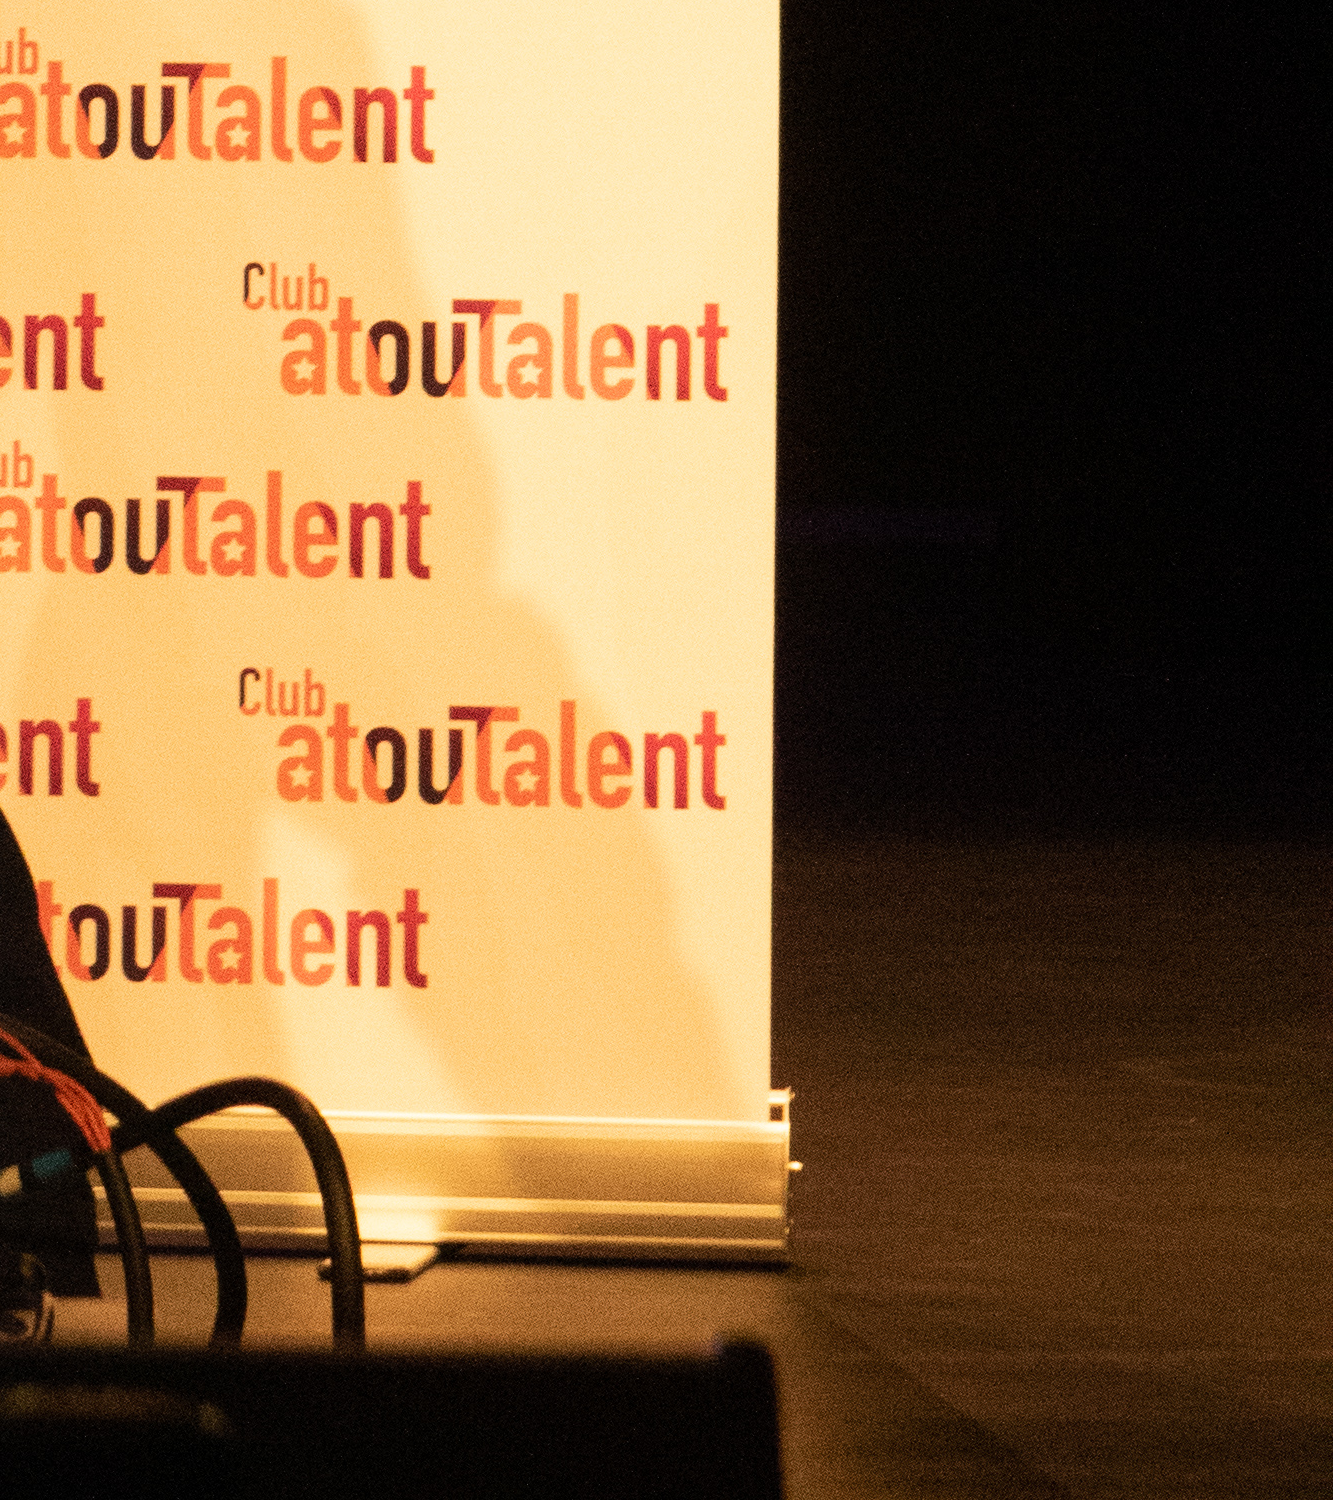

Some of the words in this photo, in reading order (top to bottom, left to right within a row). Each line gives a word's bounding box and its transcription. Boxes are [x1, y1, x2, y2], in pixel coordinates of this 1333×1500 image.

[243, 262, 329, 310] Club
[280, 293, 729, 402] atouTalent
[239, 667, 325, 716] Club
[276, 700, 726, 810] atouTalent
[37, 878, 429, 989] touTalent
